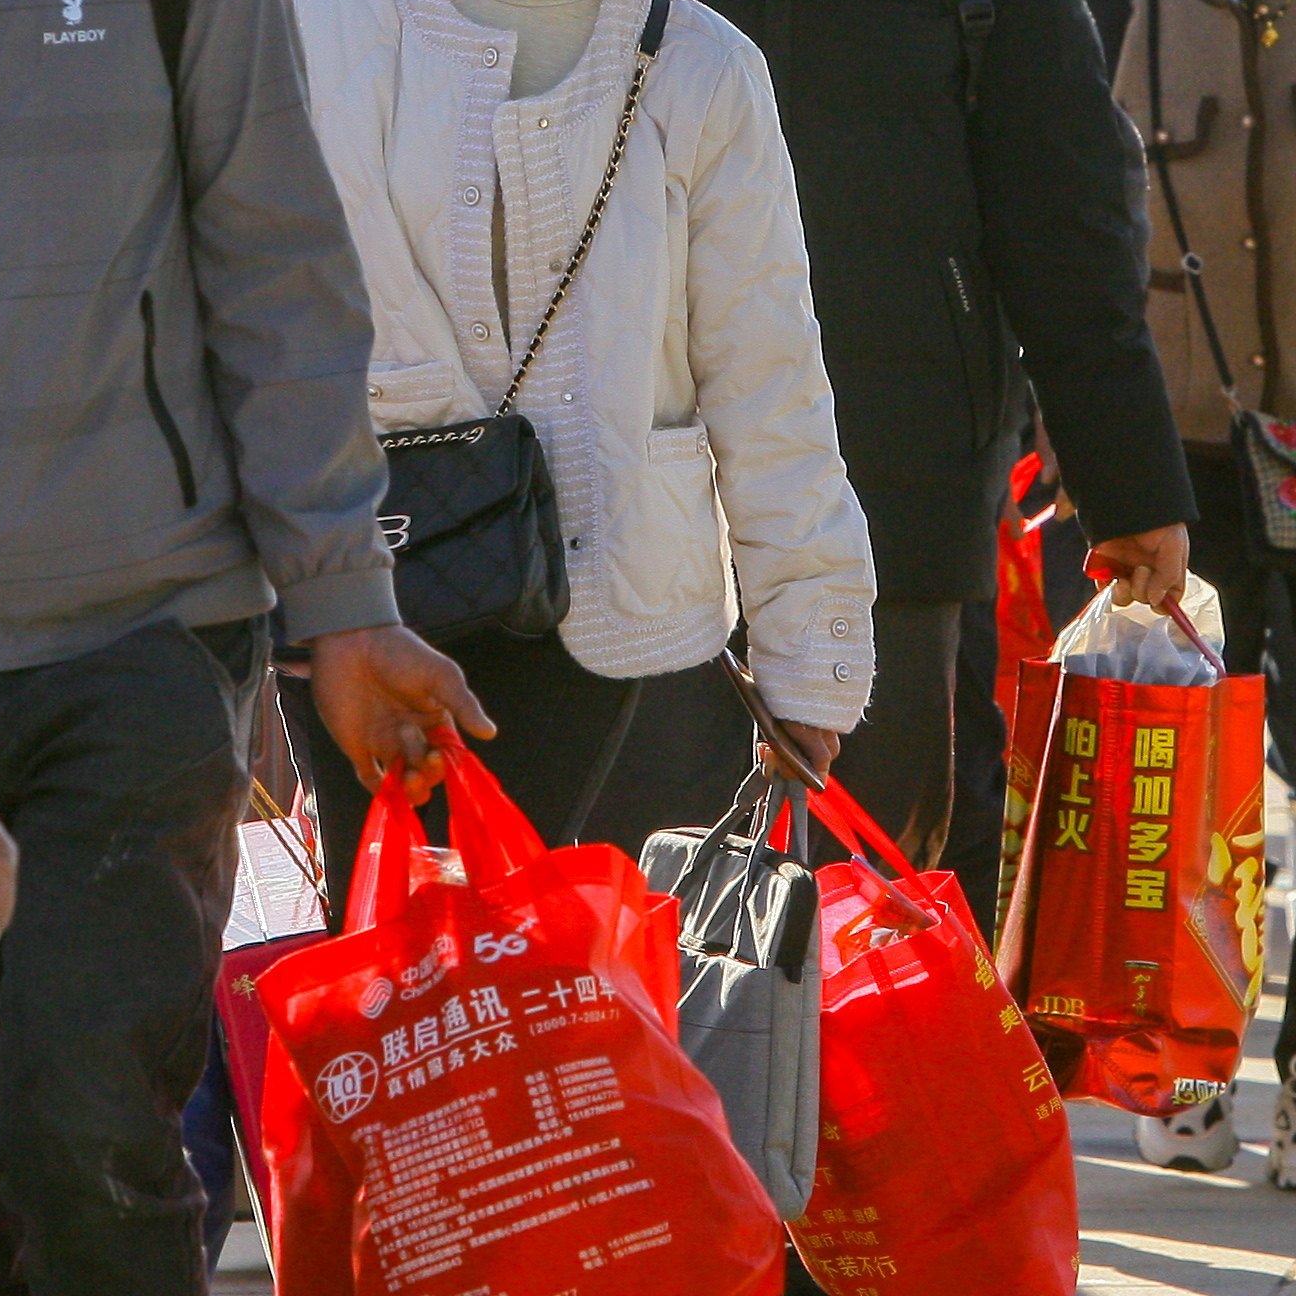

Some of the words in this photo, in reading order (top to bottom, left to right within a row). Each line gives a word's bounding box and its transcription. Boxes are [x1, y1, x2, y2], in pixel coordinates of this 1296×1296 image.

[43, 29, 106, 44] PLAYBOY
[1055, 717, 1097, 852] 怕上火
[1124, 727, 1176, 910] 喝加多宝
[473, 932, 529, 965] 5G
[521, 974, 618, 1016] 二十四年
[1035, 995, 1086, 1017] JDB
[380, 985, 509, 1067] 联启通讯
[385, 1031, 520, 1100] 真情服务大众
